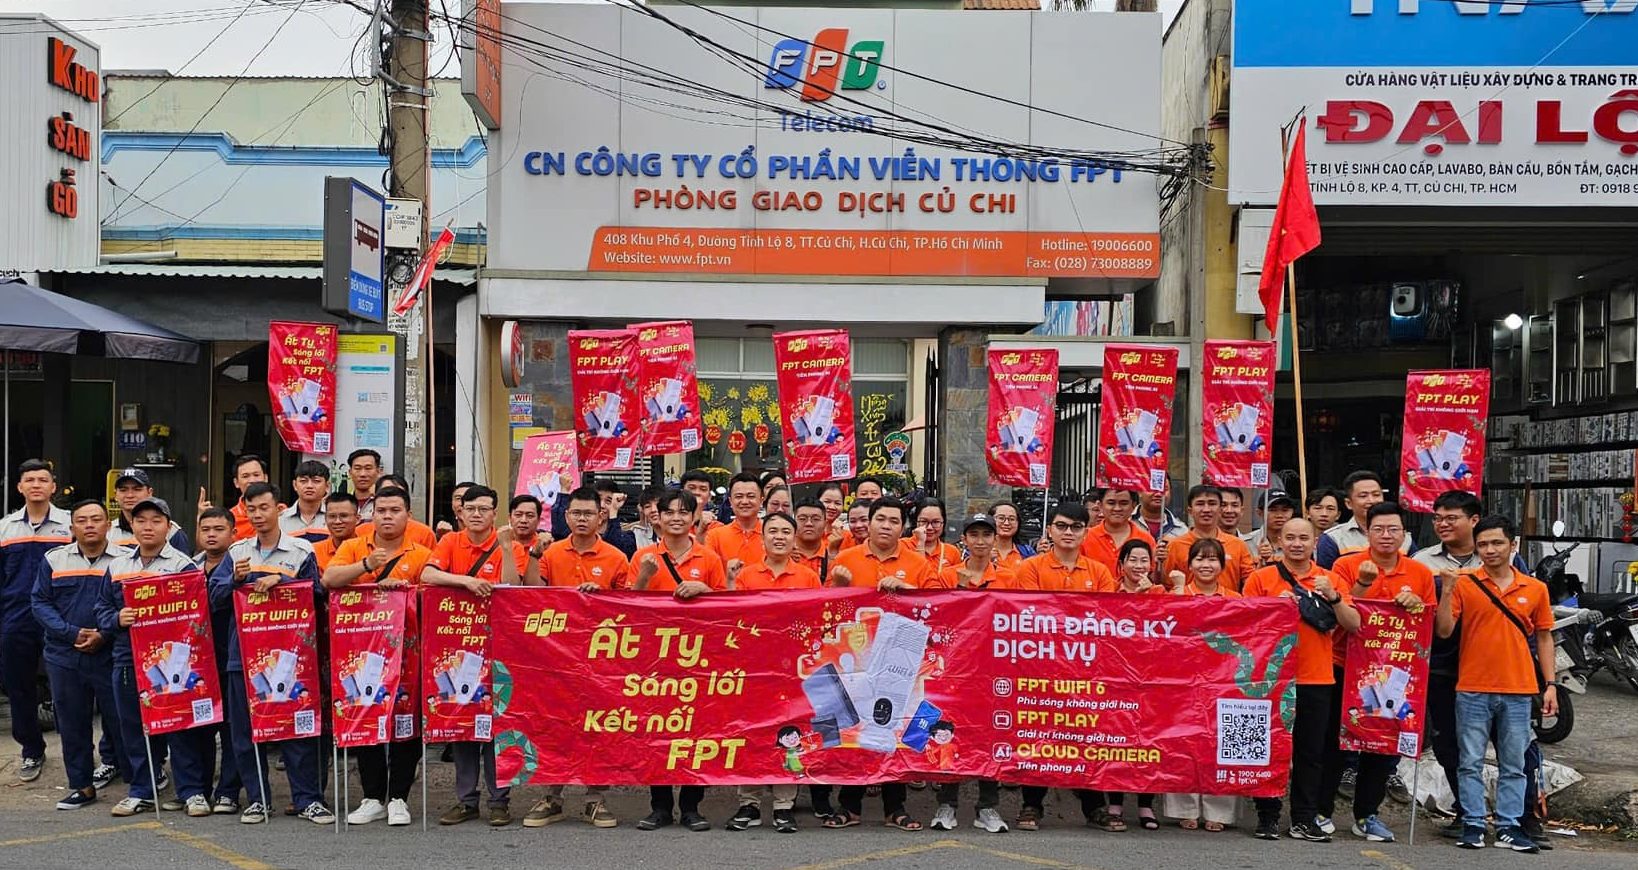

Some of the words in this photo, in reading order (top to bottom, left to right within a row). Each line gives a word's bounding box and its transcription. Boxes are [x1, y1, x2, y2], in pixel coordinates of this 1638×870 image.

[51, 37, 98, 103] KHO
[1345, 71, 1376, 86] CỬA
[1378, 71, 1417, 86] HÀNG
[1420, 72, 1448, 90] VẬT
[1450, 72, 1480, 90] LIỆU
[1483, 72, 1510, 87] XÂY
[1513, 72, 1554, 89] DỰNG
[1556, 74, 1567, 86] &
[1570, 74, 1616, 86] TRANG
[780, 112, 873, 134] Telecom
[1316, 99, 1503, 156] ĐẠI
[524, 151, 565, 176] CN
[575, 146, 662, 177] CÔNG
[672, 154, 711, 177] TY
[719, 145, 758, 179] CỔ
[769, 147, 860, 180] PHẦN
[868, 147, 957, 182] VIỄN
[1071, 159, 1127, 184] FPT
[1320, 163, 1332, 177] BỊ
[1334, 161, 1349, 177] VỆ
[1352, 163, 1380, 174] SINH
[1382, 163, 1407, 174] CAO
[1409, 160, 1435, 177] CẤP,
[1438, 163, 1486, 177] LAVABO,
[1489, 161, 1513, 175] BÀN
[1605, 163, 1638, 178] GẠCH
[1358, 183, 1368, 194] 8,
[1371, 183, 1388, 193] KP.
[1391, 183, 1402, 194] 4,
[1404, 183, 1421, 194] TT,
[1443, 183, 1467, 194] CHI,
[1470, 184, 1487, 194] TP.
[1489, 184, 1517, 194] HCM
[1580, 184, 1599, 194] ĐT:
[1602, 184, 1630, 194] 0918
[634, 185, 737, 210] PHÒNG
[752, 190, 822, 211] GIAO
[839, 191, 905, 218] DỊCH
[919, 187, 956, 213] CỦ
[970, 193, 1016, 213] CHI
[604, 233, 627, 245] 408
[631, 233, 653, 245] Khu
[656, 233, 680, 246] Phố
[683, 235, 695, 248] 4,
[768, 236, 782, 250] Lộ
[785, 236, 796, 249] 8,
[835, 236, 856, 250] Chi,
[889, 237, 910, 250] Chi,
[973, 238, 1003, 250] Minh
[1041, 239, 1088, 250] Hotline:
[1091, 240, 1153, 252] 19006600
[604, 251, 656, 264] Website:
[659, 252, 732, 267] www.fpt.vn
[1026, 257, 1051, 268] Fax:
[1054, 257, 1087, 271] (028)
[1091, 258, 1152, 270] 73008889
[652, 343, 690, 356] CAMERA
[577, 356, 598, 367] FPT
[600, 355, 629, 366] PLAY
[782, 361, 800, 371] FPT
[802, 357, 845, 369] CAMERA
[303, 366, 325, 375] FPT
[1011, 373, 1053, 382] CAMERA
[1112, 372, 1131, 381] FPT
[1131, 373, 1173, 384] CAMERA
[1212, 366, 1235, 376] FPT
[1237, 366, 1268, 377] PLAY
[1416, 393, 1442, 404] FPT
[1443, 394, 1480, 405] PLAY
[158, 600, 187, 614] WIFI
[191, 599, 198, 609] 6
[242, 612, 267, 623] FPT
[269, 609, 298, 621] WIFI
[301, 608, 308, 619] 6
[336, 613, 360, 624] FPT
[362, 610, 394, 622] PLAY
[993, 606, 1058, 635] ĐIỂM
[1064, 611, 1137, 638] ĐĂNG
[1143, 615, 1178, 639] KÝ
[462, 636, 487, 646] FPT
[588, 614, 640, 659] Ất
[993, 639, 1055, 664] DỊCH
[1062, 641, 1097, 667] VỤ
[1389, 651, 1416, 663] FPT
[622, 672, 699, 703] Sáng
[707, 668, 746, 696] lối
[1017, 678, 1049, 693] FPT
[1054, 680, 1091, 695] WIFI
[1096, 682, 1106, 695] 6
[1017, 696, 1037, 705] Phủ
[1039, 697, 1064, 708] sóng
[1066, 698, 1098, 710] không
[1099, 700, 1118, 710] giới
[1119, 702, 1139, 711] hạn
[583, 706, 639, 733] Kết
[646, 704, 696, 733] nối
[1017, 710, 1049, 725] FPT
[1054, 713, 1100, 728] PLAY
[1017, 729, 1037, 739] Giải
[1052, 731, 1084, 742] không
[1107, 734, 1127, 744] hạn
[666, 738, 746, 771] FPT
[1017, 743, 1080, 759] CLOUD
[1084, 747, 1161, 763] CAMERA
[1017, 761, 1038, 771] Tiên
[1040, 763, 1072, 774] phong
[1074, 765, 1086, 773] AI
